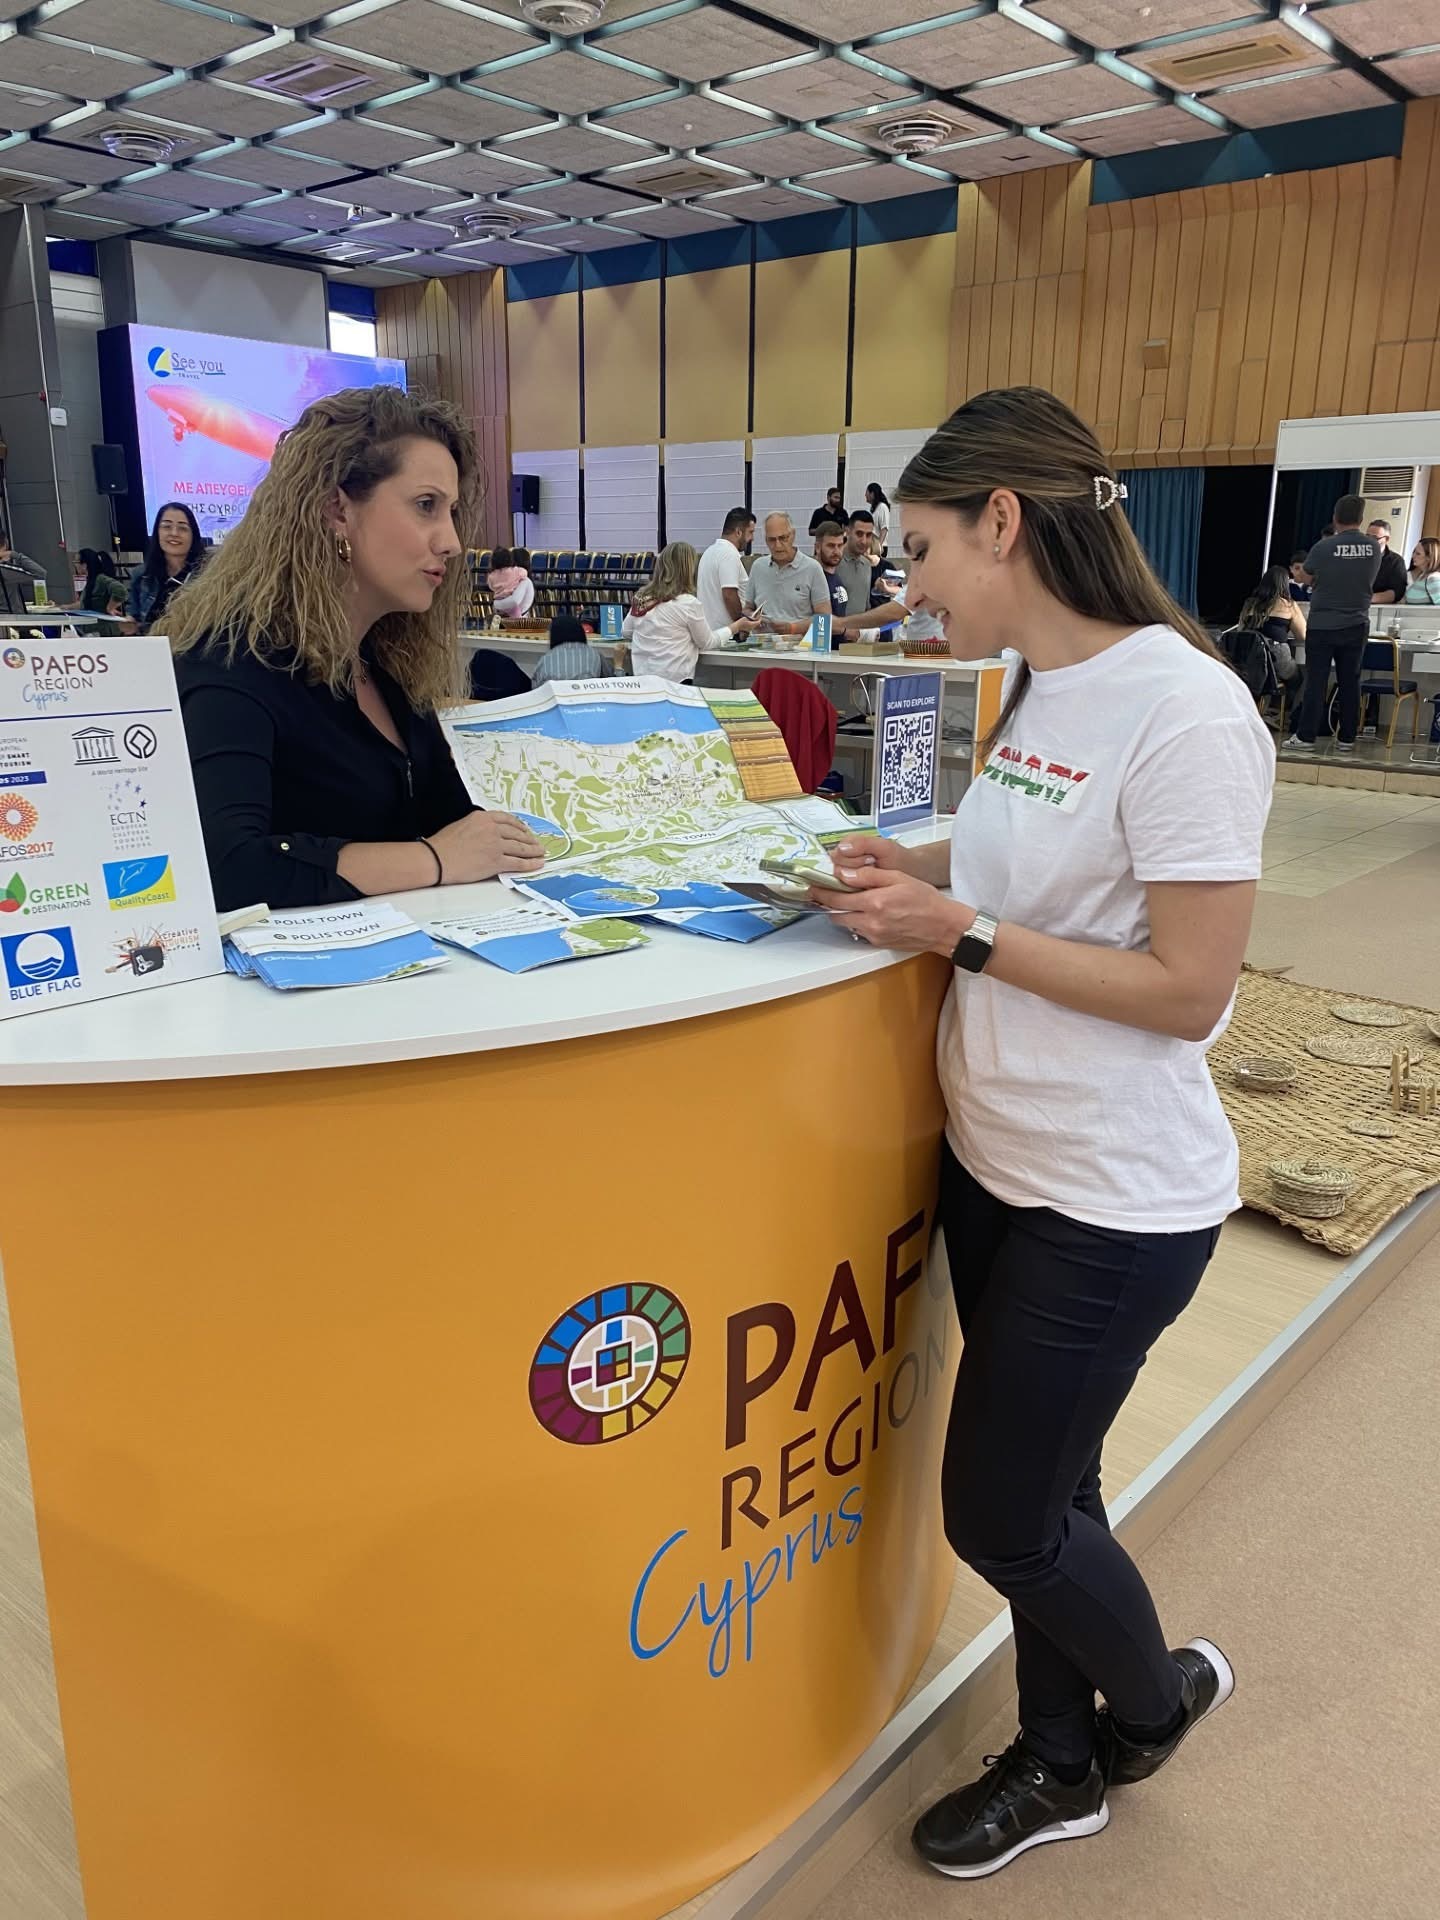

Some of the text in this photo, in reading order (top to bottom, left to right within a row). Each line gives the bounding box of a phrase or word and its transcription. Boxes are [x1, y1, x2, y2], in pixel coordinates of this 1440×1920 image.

[171, 352, 224, 374] See you
[1333, 544, 1373, 557] JEANS
[30, 653, 109, 676] PAFOS
[34, 677, 94, 691] REGION
[583, 681, 641, 690] POLIS TOWN
[22, 684, 69, 711] Cyprus
[886, 696, 936, 710] SCAN TO EXPLORE
[109, 810, 146, 825] ECTN
[30, 882, 90, 904] GREEN
[115, 892, 170, 907] QualityCoast
[32, 898, 92, 914] DESTINATIONS
[274, 911, 364, 926] POLIS TOWN
[290, 922, 381, 941] POLIS TOWN
[10, 977, 81, 1000] BLUE FLAG
[725, 1208, 950, 1450] PAF
[721, 1305, 948, 1551] REGION
[630, 1486, 864, 1677] Cyprus
